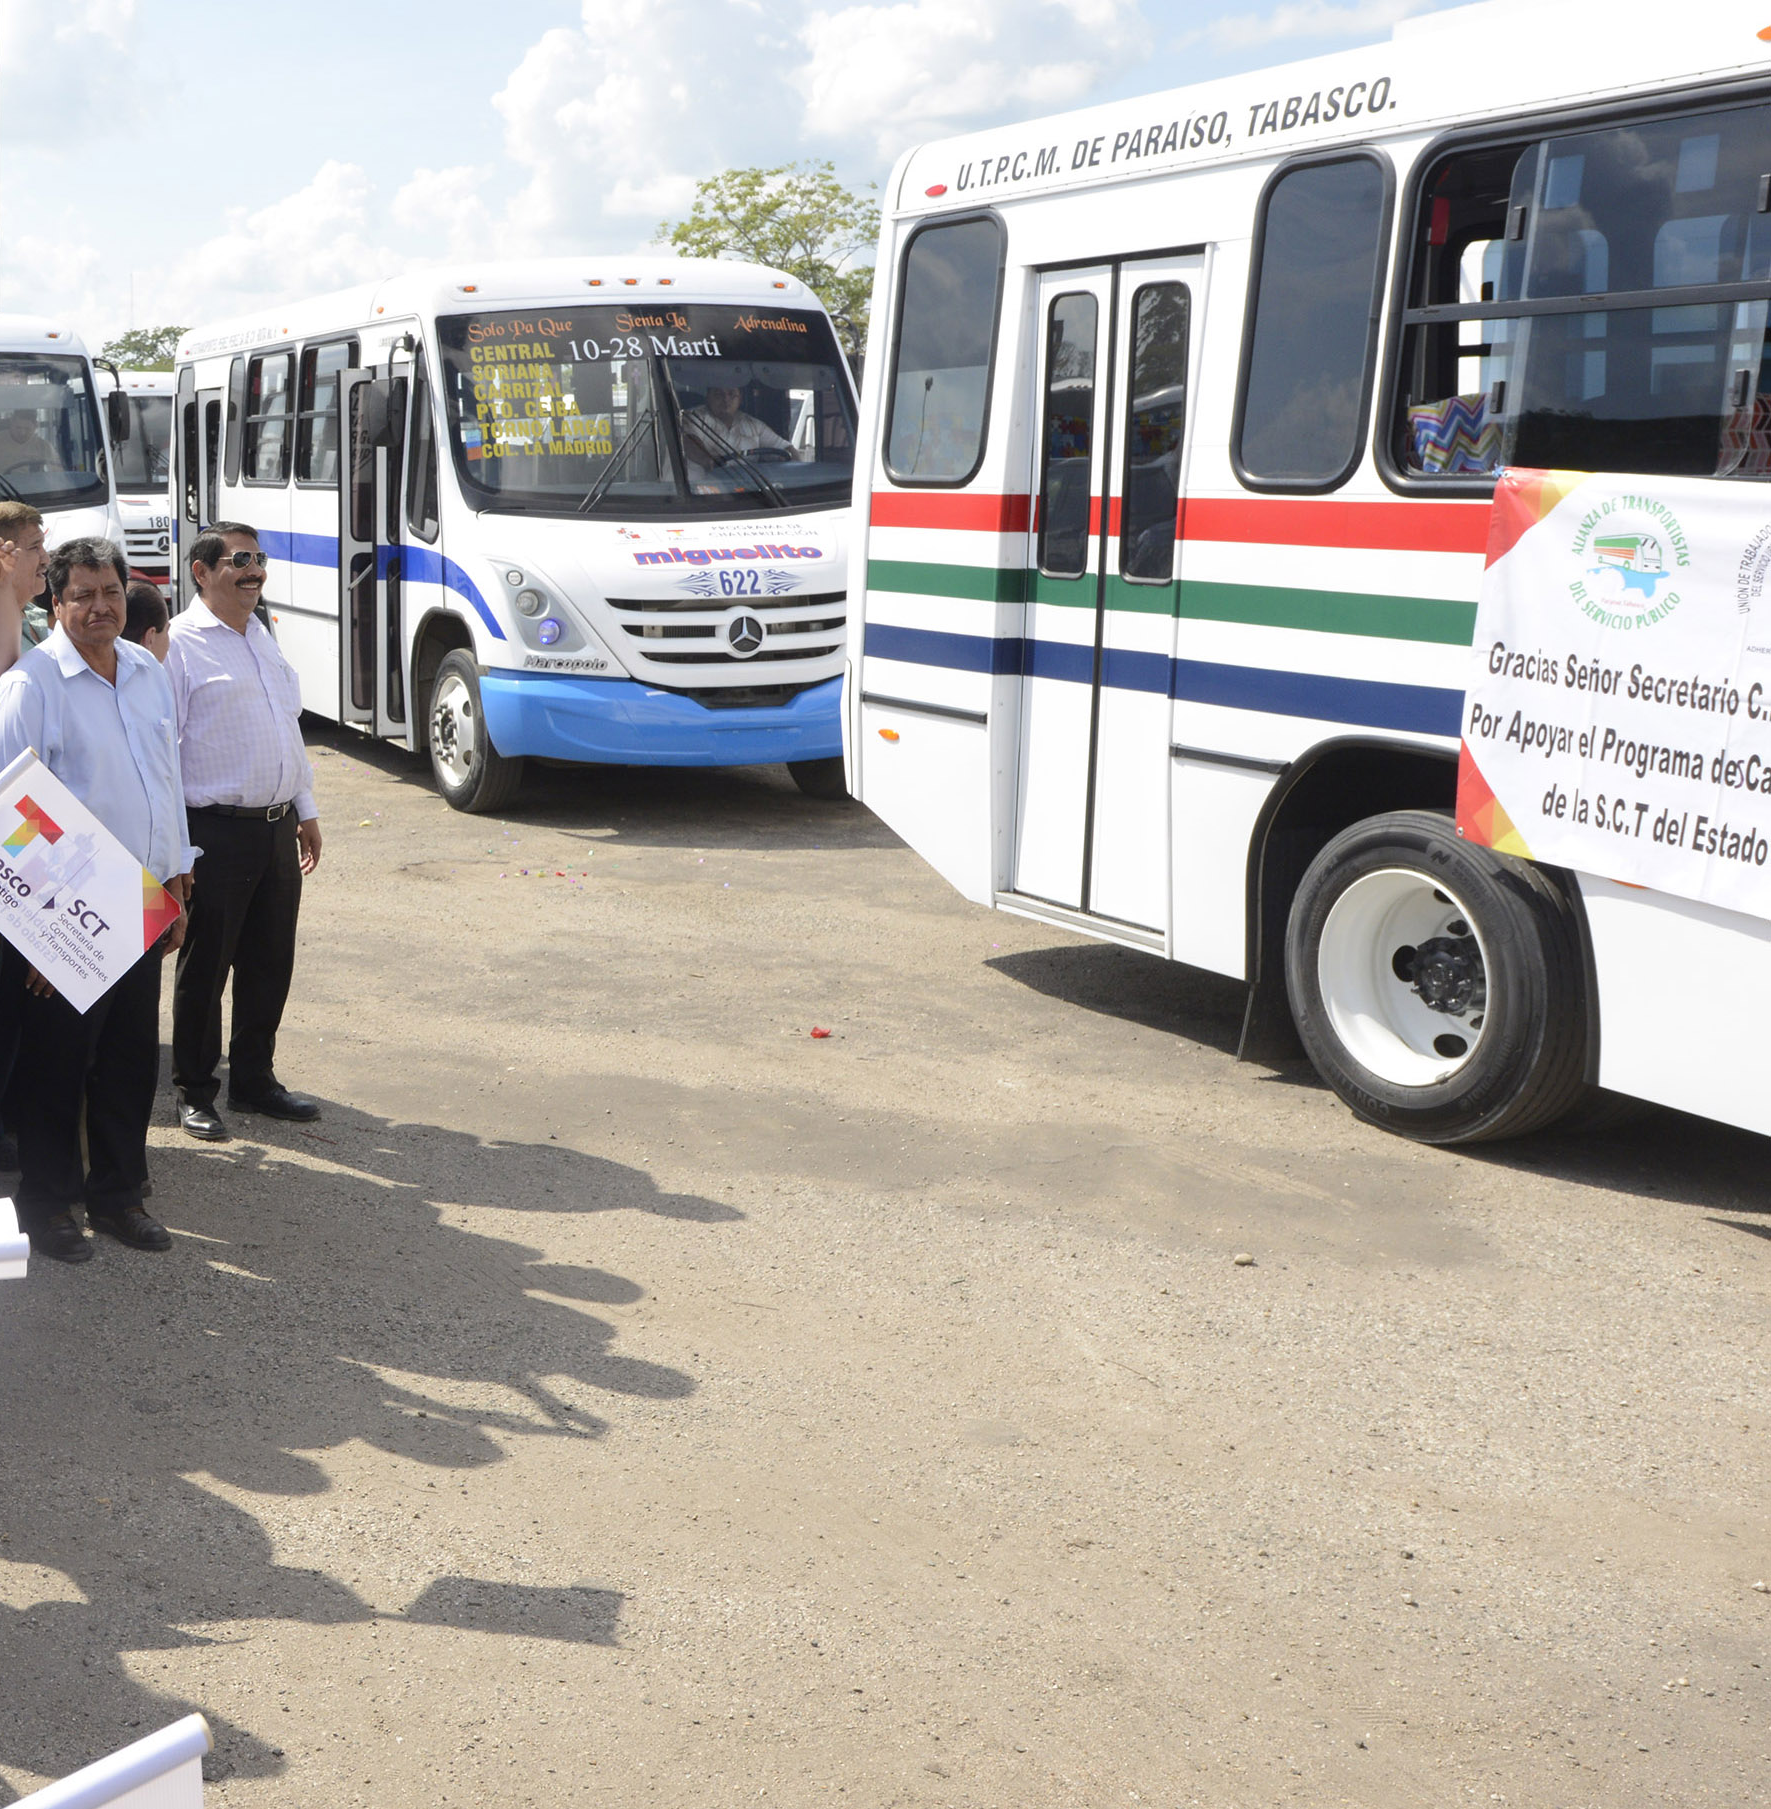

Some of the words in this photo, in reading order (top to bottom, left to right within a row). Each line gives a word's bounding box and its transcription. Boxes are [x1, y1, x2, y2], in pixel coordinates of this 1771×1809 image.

[956, 146, 1061, 192] U.T.P.C.M.
[1071, 136, 1105, 170] DE
[1111, 110, 1232, 163] PARAÍSO,
[1247, 76, 1398, 138] TABASCO.
[538, 318, 573, 338] Que
[616, 313, 664, 332] Sienta
[733, 314, 808, 333] Adrenalina
[470, 342, 556, 363] CENTRAL
[569, 336, 644, 361] 10-28
[648, 335, 722, 357] Marti
[472, 362, 555, 382] SORIANA
[474, 381, 565, 400] CARRIZAL
[476, 402, 519, 421] PTO.
[525, 400, 581, 418] CEIBA
[479, 421, 544, 441] TORNO
[549, 419, 611, 438] LARGO
[481, 443, 519, 459] COL.
[524, 442, 544, 456] LA
[548, 441, 613, 456] MADRID
[1572, 509, 1602, 556] ALIANZA
[1601, 498, 1618, 515] DE
[1622, 495, 1690, 567] TRANSPORTISTAS
[633, 544, 823, 566] miguelito
[719, 569, 762, 596] 622
[1738, 573, 1751, 586] DE
[1569, 581, 1588, 604] DEL
[1581, 600, 1633, 630] SERVICIO
[523, 655, 608, 671] Marcopolo
[1489, 641, 1559, 685] Gracias
[1564, 653, 1623, 695] Señor
[1628, 663, 1739, 716] Secretario
[1747, 682, 1771, 721] C.
[1470, 702, 1503, 739] Por
[1505, 710, 1574, 759] Apoyar
[1579, 725, 1597, 759] el
[1600, 727, 1704, 780] Programa
[1542, 783, 1567, 818] de
[1572, 788, 1589, 824] la
[1595, 794, 1650, 838] S.C.T
[1652, 808, 1688, 847] del
[1692, 815, 1768, 866] Estado
[67, 899, 110, 938] SCT
[57, 913, 94, 953] Secretaría
[93, 950, 105, 962] de
[49, 921, 109, 982] Comunicaciones
